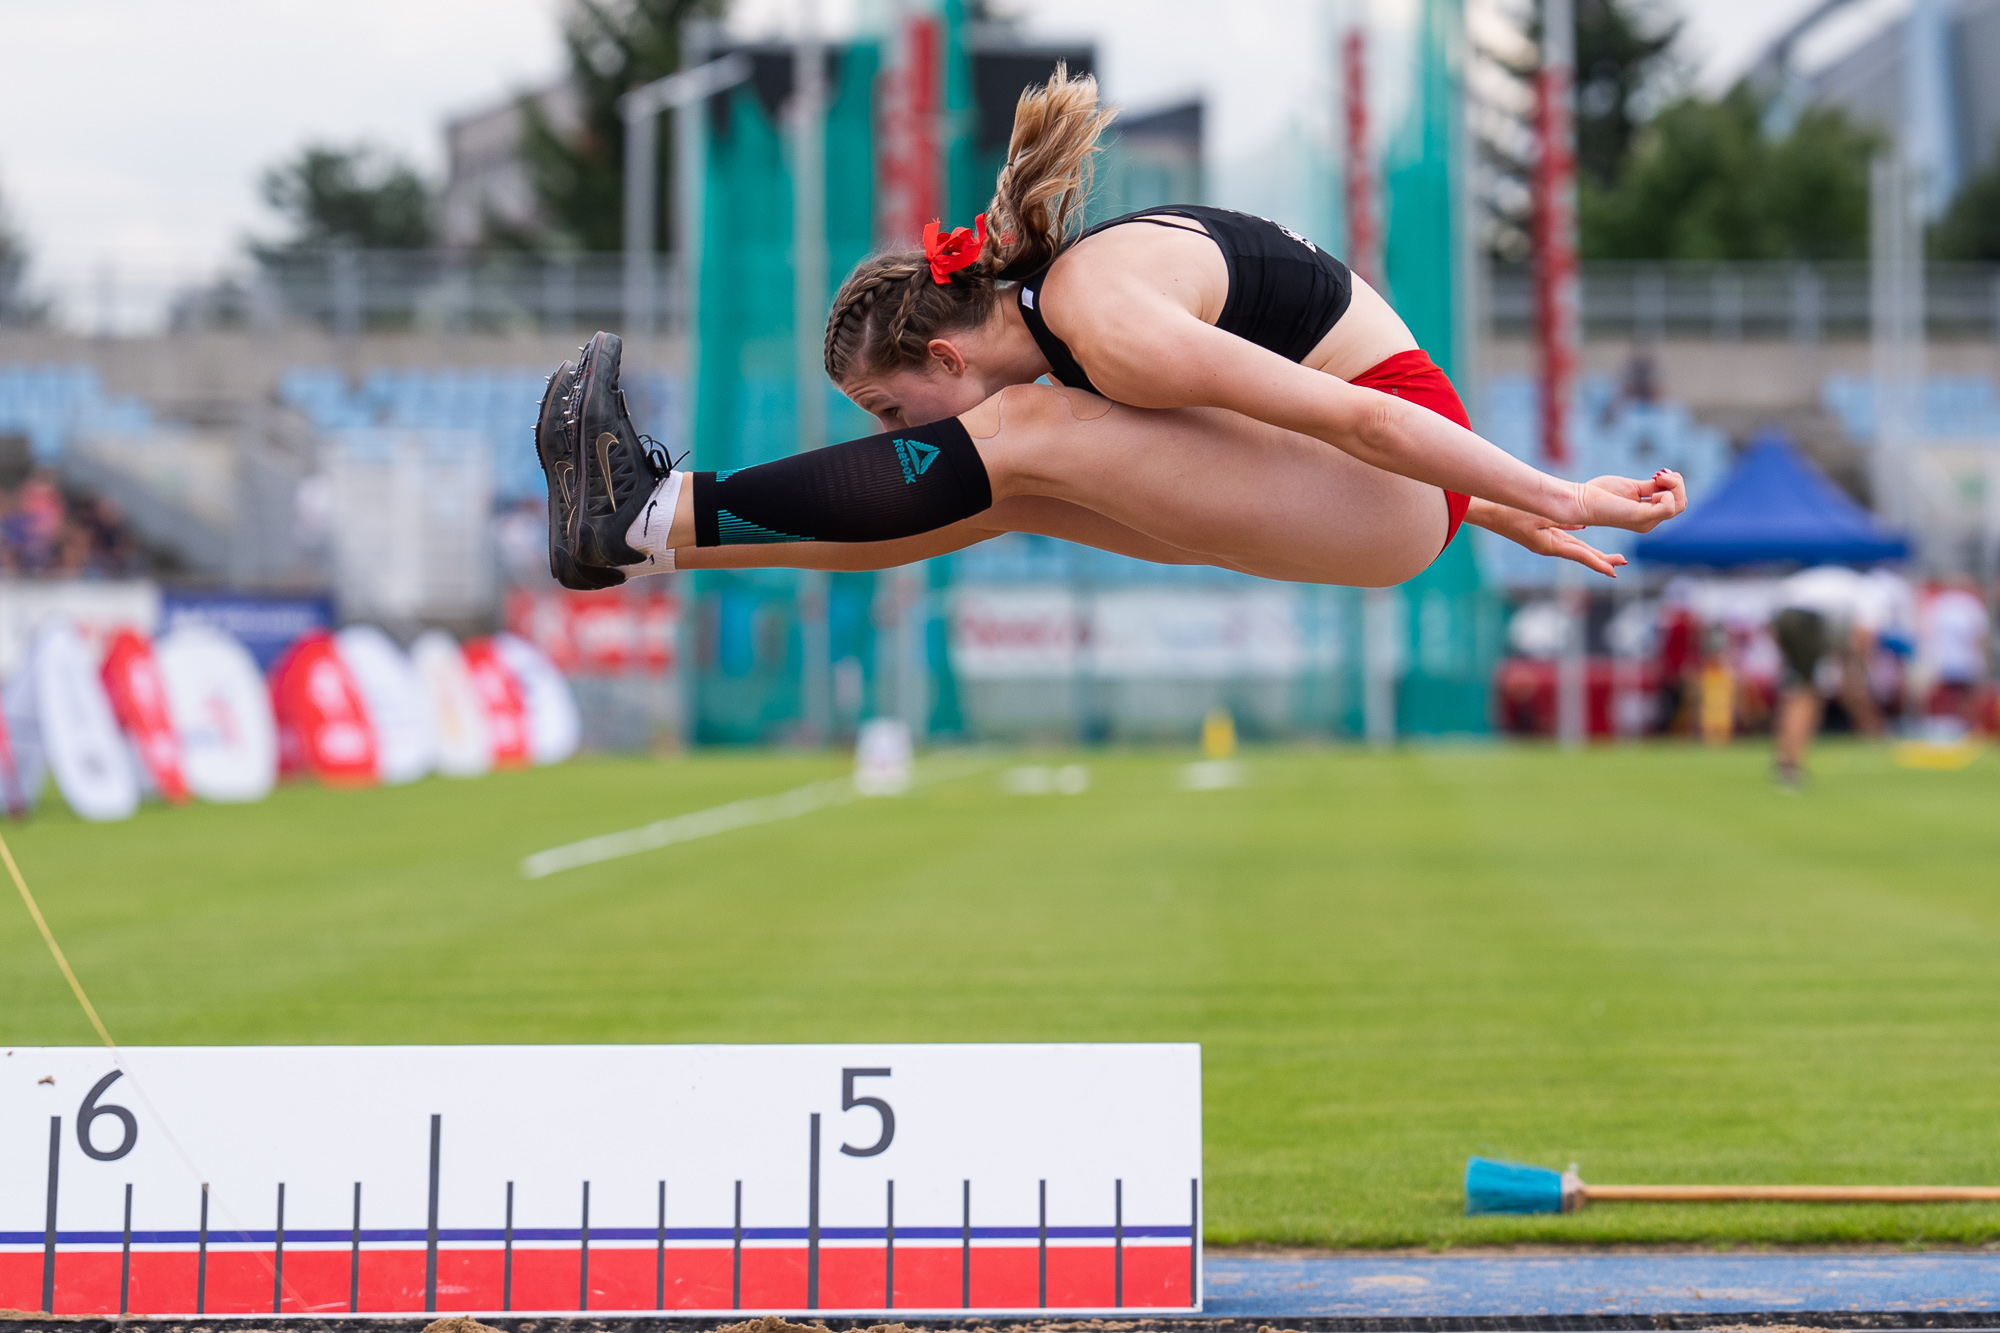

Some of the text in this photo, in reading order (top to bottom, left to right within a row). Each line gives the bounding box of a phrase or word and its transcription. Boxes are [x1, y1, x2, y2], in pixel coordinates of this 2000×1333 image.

[893, 438, 916, 484] Reebok
[76, 1069, 138, 1162] 6
[839, 1067, 896, 1158] 5
